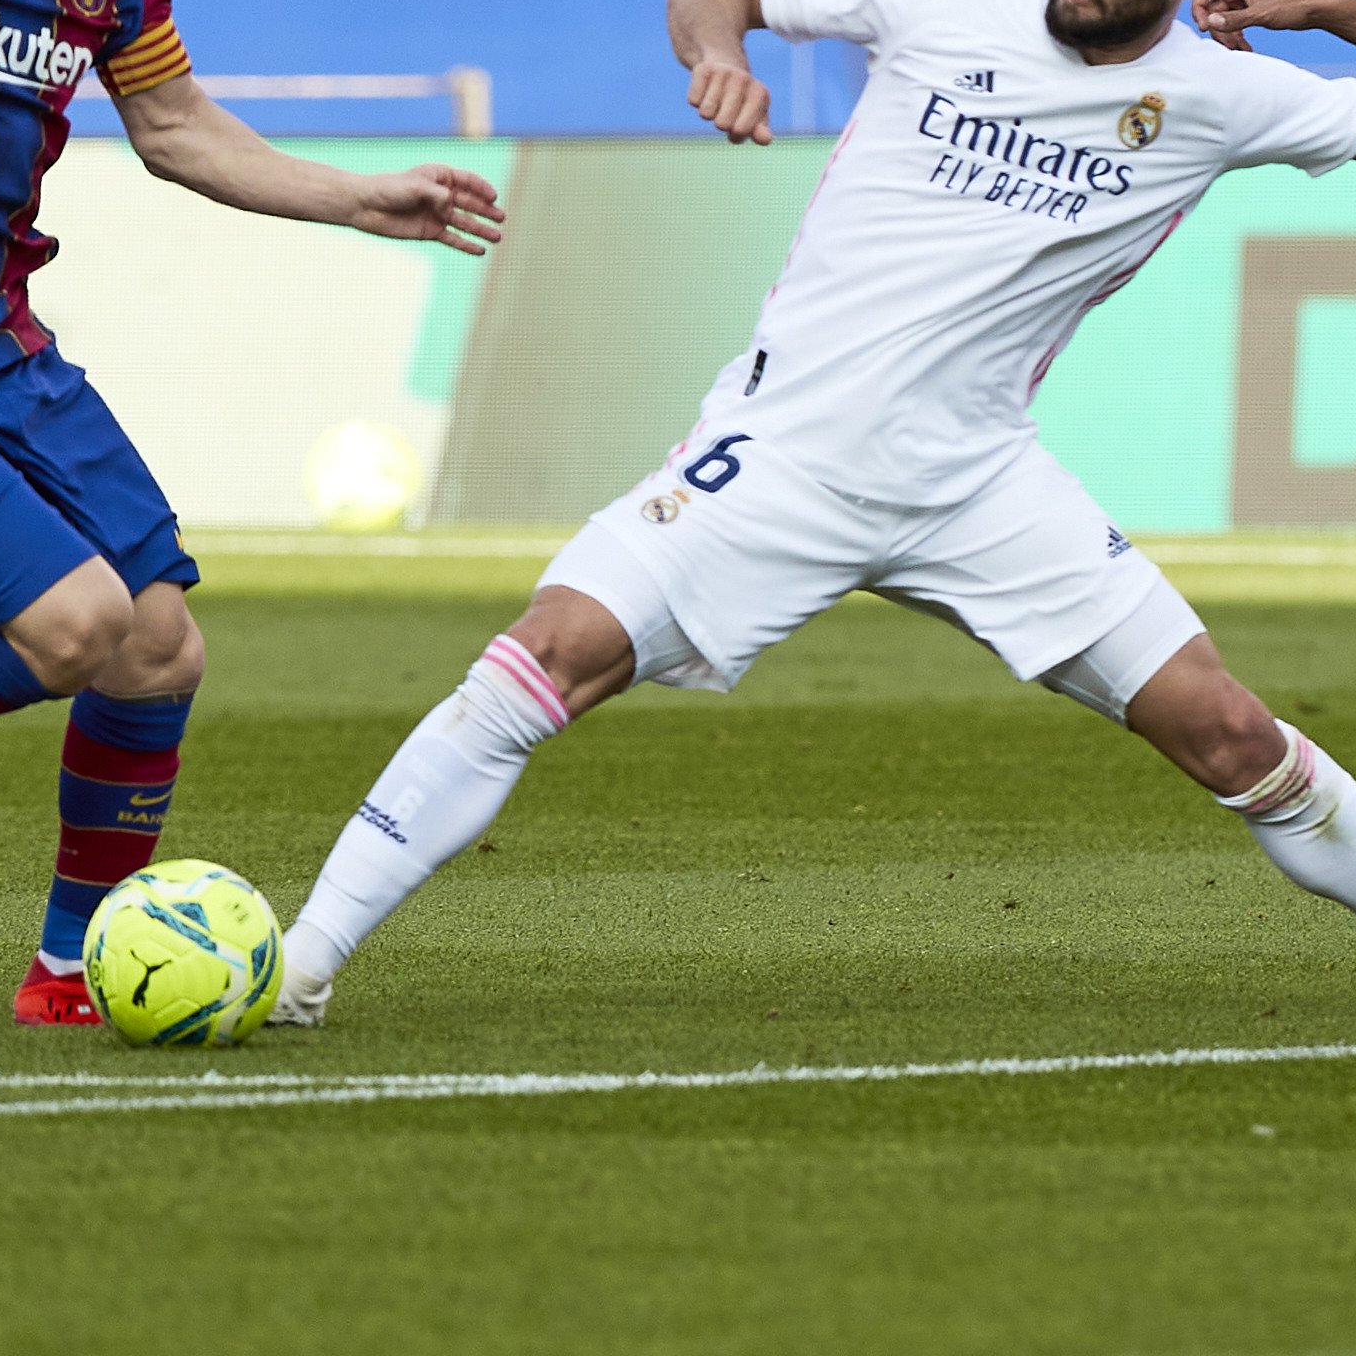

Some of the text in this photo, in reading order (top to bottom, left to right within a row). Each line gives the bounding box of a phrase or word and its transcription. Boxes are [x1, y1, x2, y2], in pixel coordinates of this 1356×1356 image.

[919, 92, 1134, 196] Emirates
[929, 154, 1089, 224] FLY BETTER
[684, 434, 755, 493] 6
